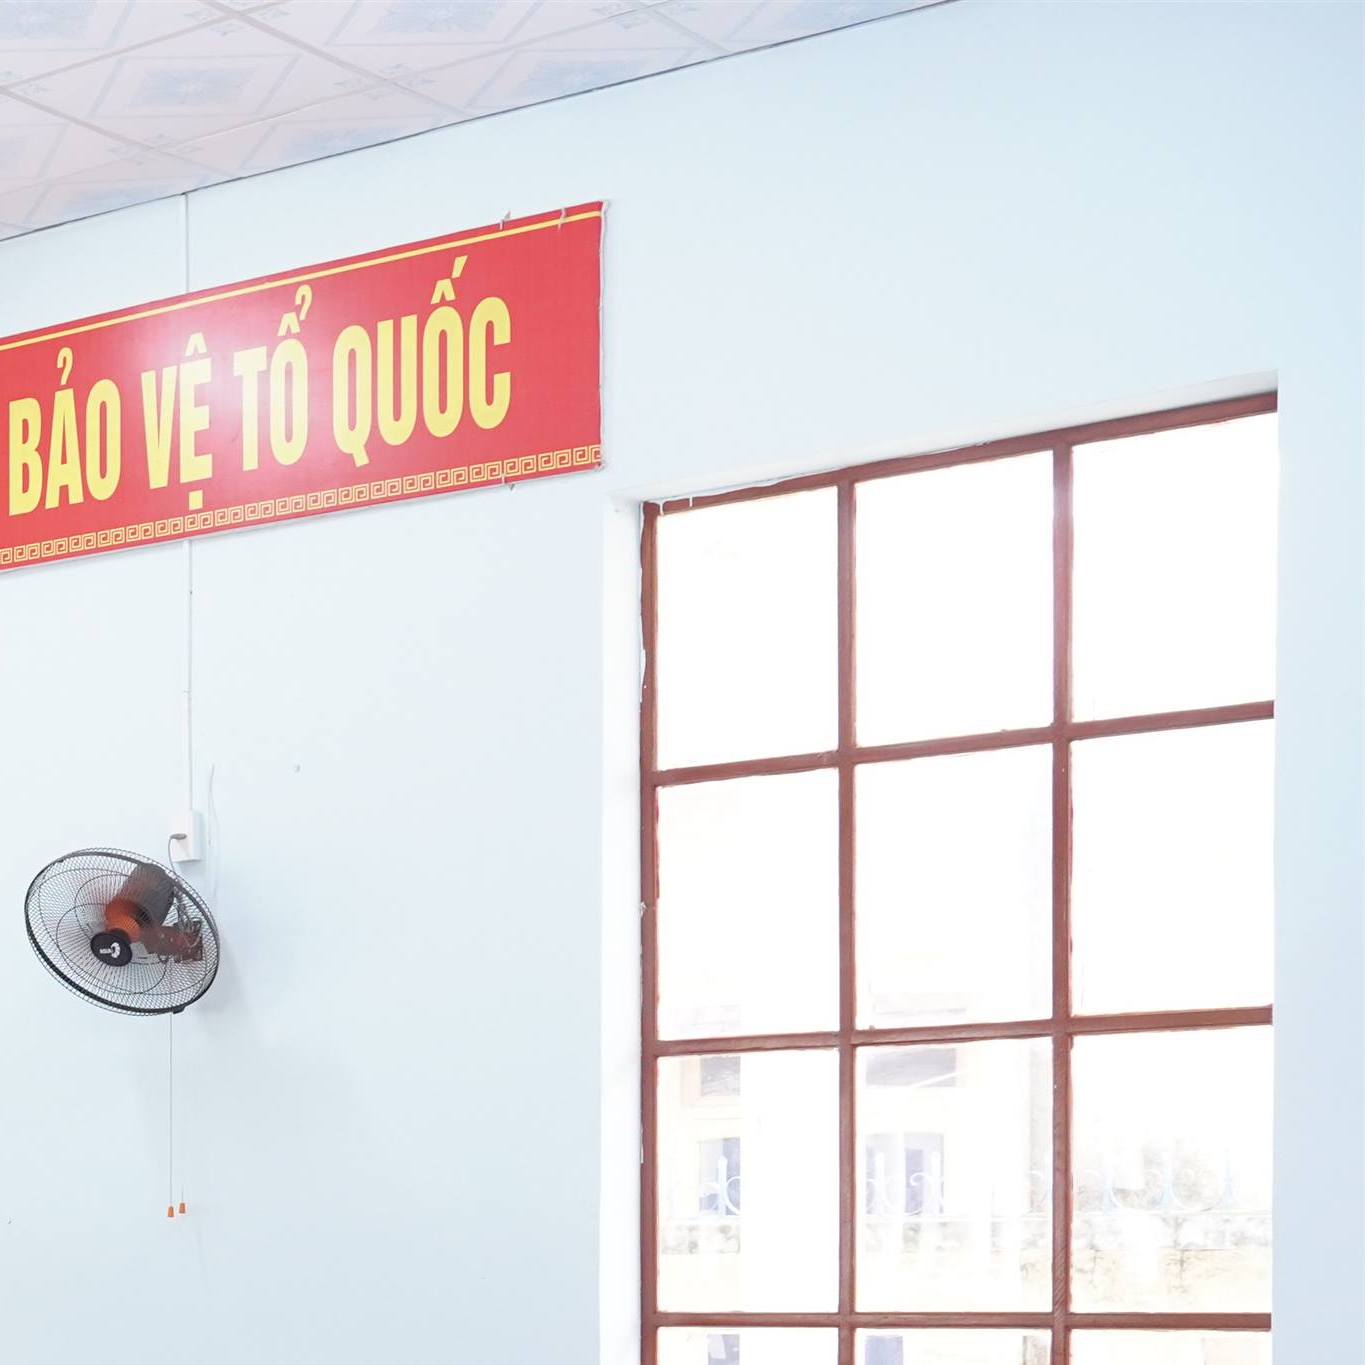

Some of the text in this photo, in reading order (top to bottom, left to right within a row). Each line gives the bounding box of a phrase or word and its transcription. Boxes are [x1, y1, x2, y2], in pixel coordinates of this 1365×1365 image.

[8, 347, 121, 516] BẢO
[141, 332, 213, 510] VỆ
[232, 285, 313, 472] TỔ
[332, 255, 511, 467] QUỐC
